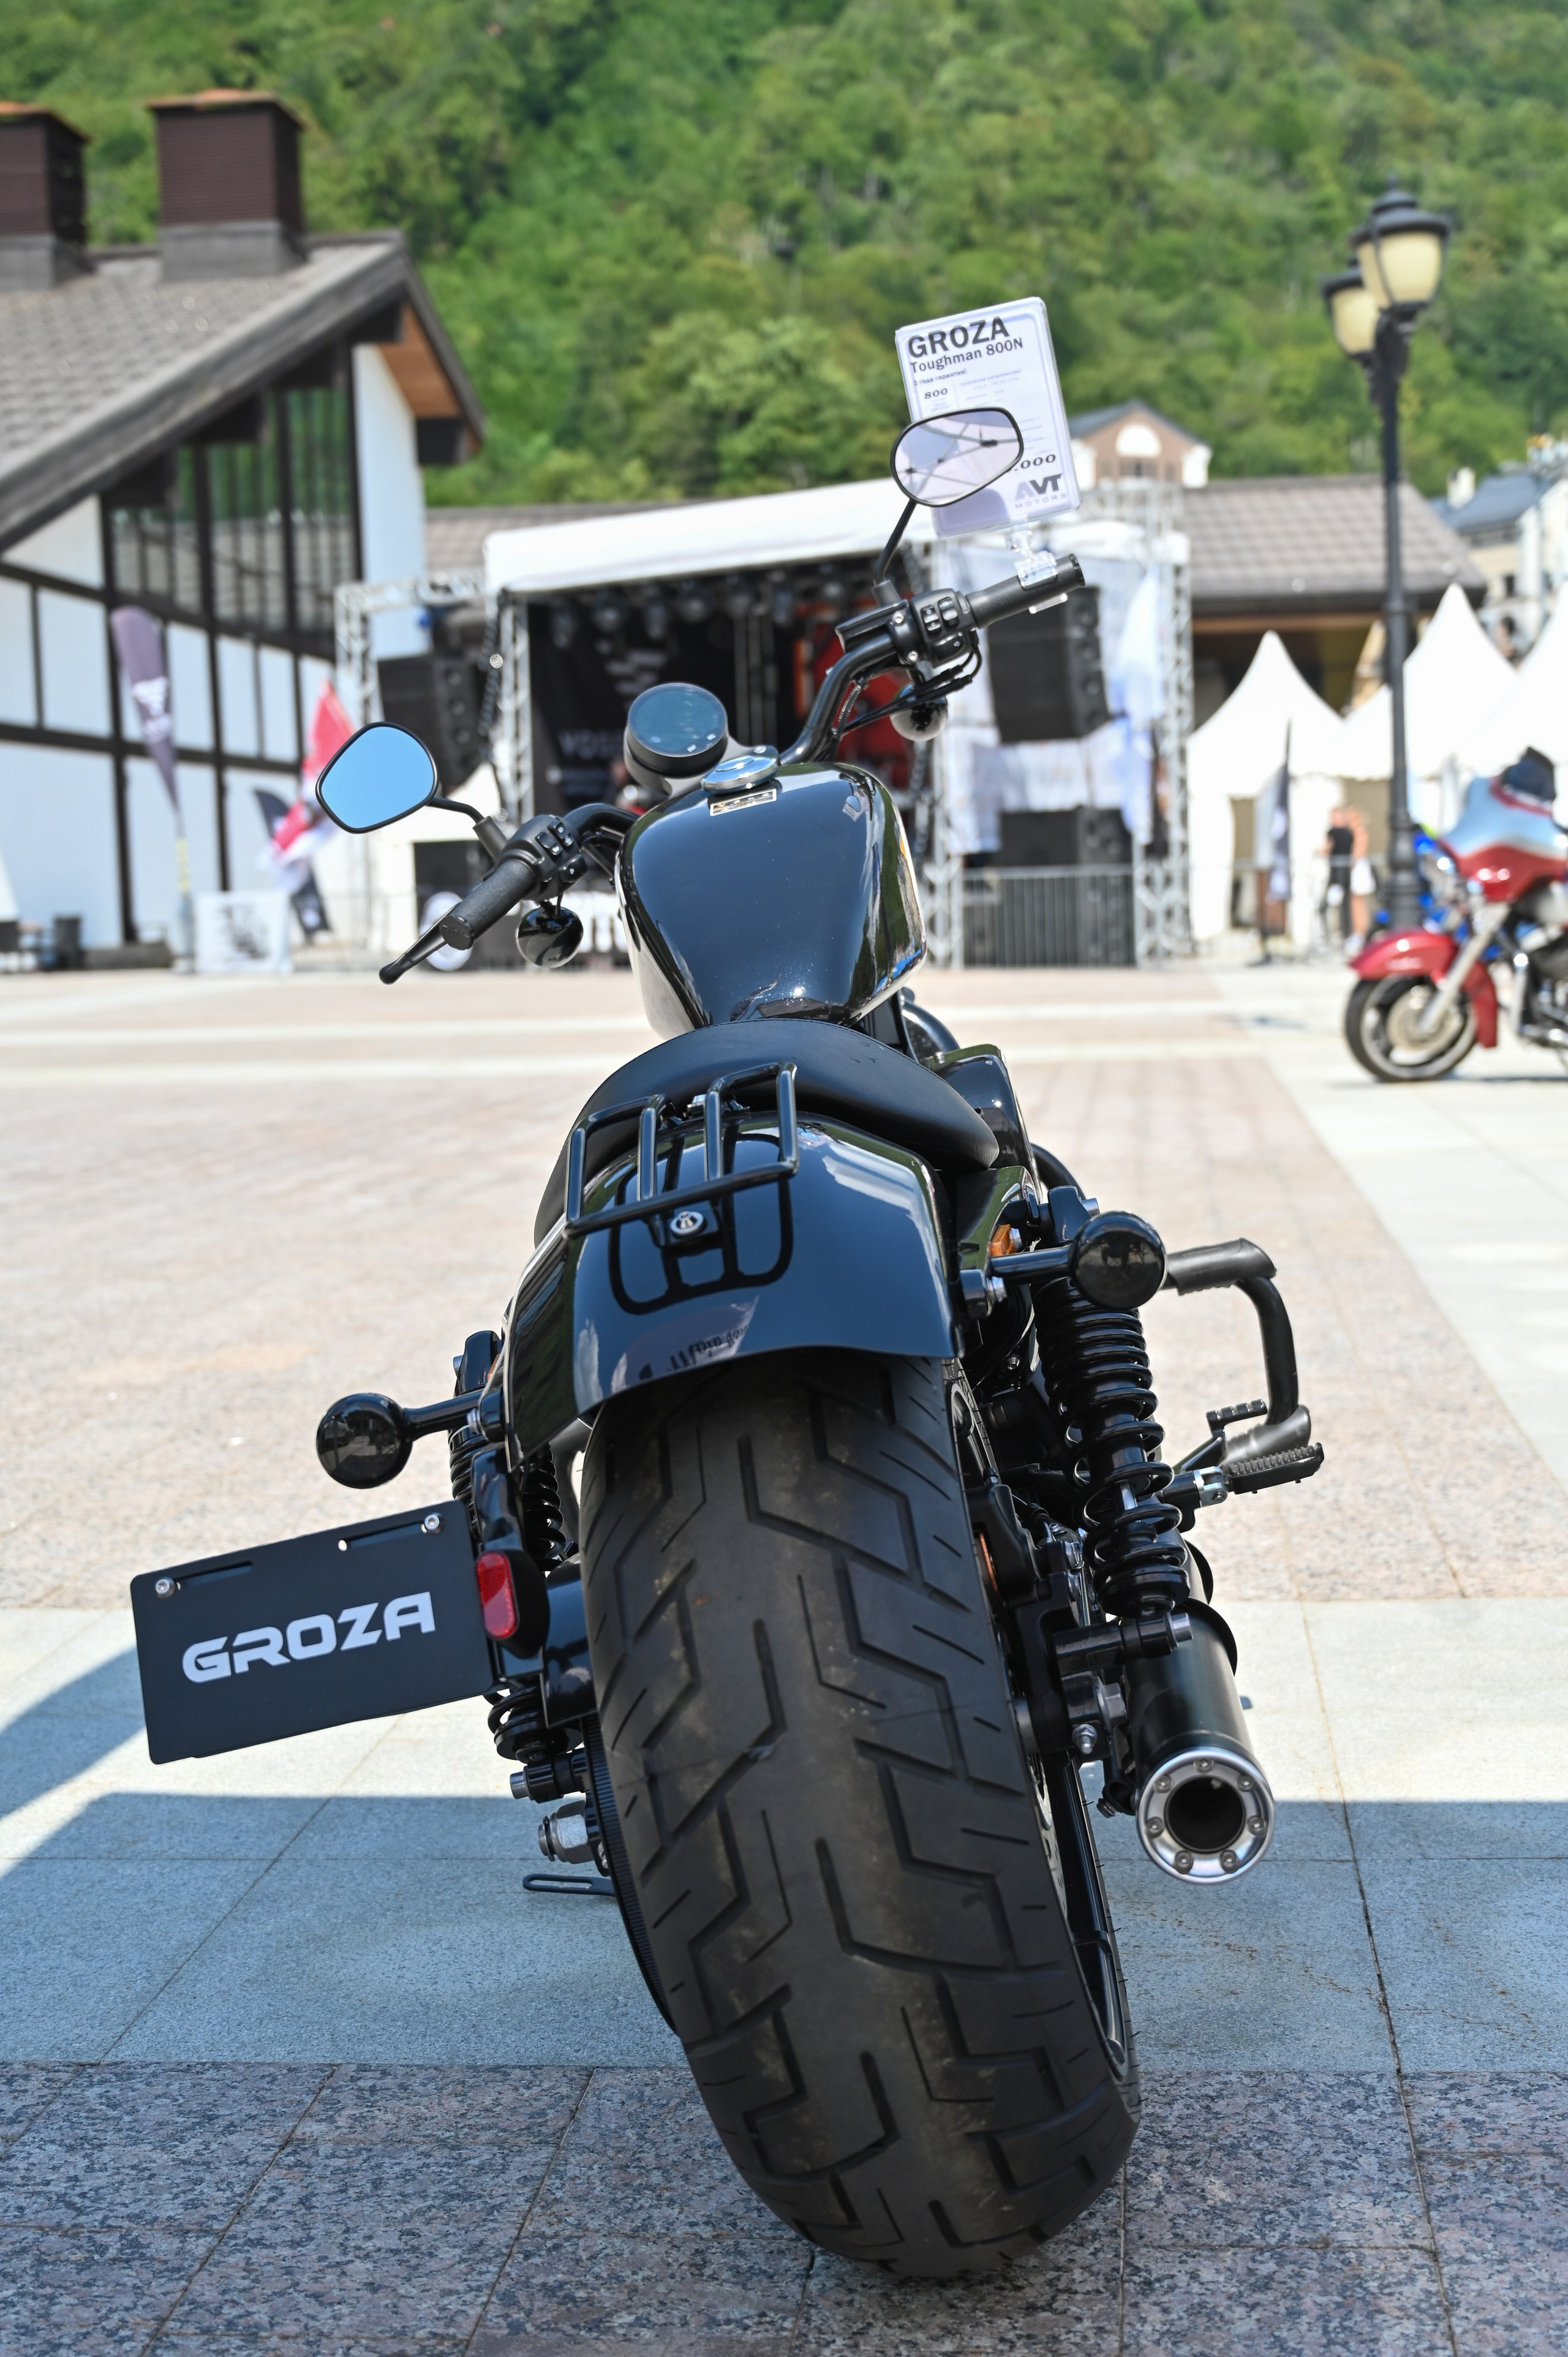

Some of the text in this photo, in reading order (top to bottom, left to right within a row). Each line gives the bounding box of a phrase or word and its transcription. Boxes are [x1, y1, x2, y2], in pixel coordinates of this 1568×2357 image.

[908, 316, 1009, 358] GROZA
[910, 337, 1023, 373] Toughman 800N
[924, 388, 948, 399] 800
[1014, 454, 1056, 472] .000
[1014, 473, 1062, 501] AVT
[1015, 493, 1067, 509] MOTORS
[182, 1591, 436, 1683] GROZA
